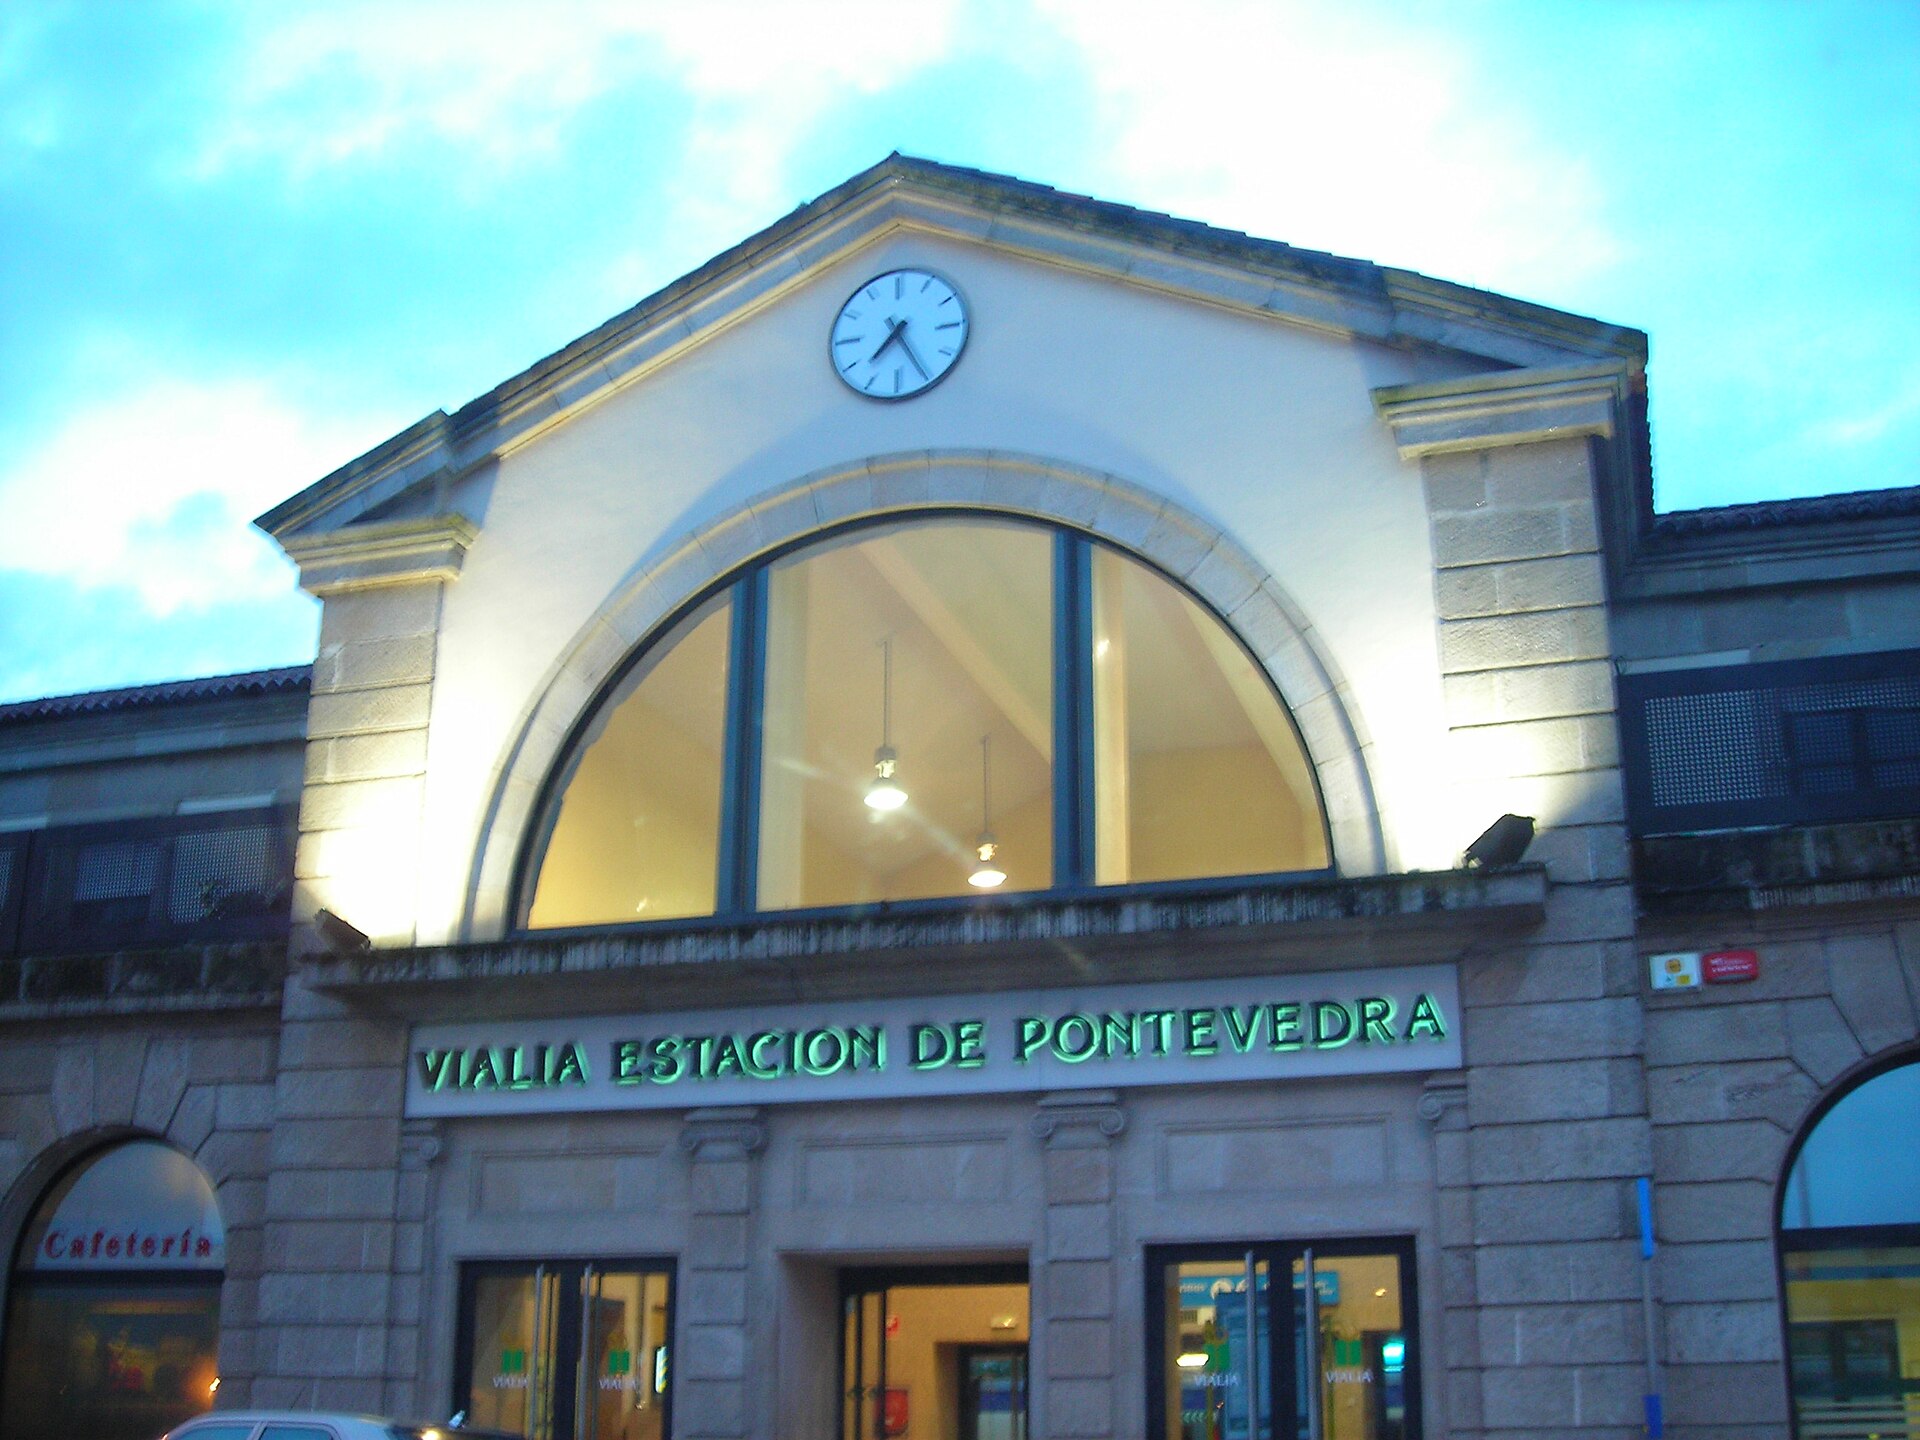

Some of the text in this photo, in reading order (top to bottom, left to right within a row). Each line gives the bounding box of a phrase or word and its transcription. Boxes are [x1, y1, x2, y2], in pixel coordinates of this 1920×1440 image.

[417, 993, 1447, 1093] VIALIA ESTACION DE PONTEVEDRA
[45, 1228, 211, 1259] Cafetería
[1194, 1372, 1239, 1387] VIALIA
[1325, 1369, 1374, 1384] VIALIA
